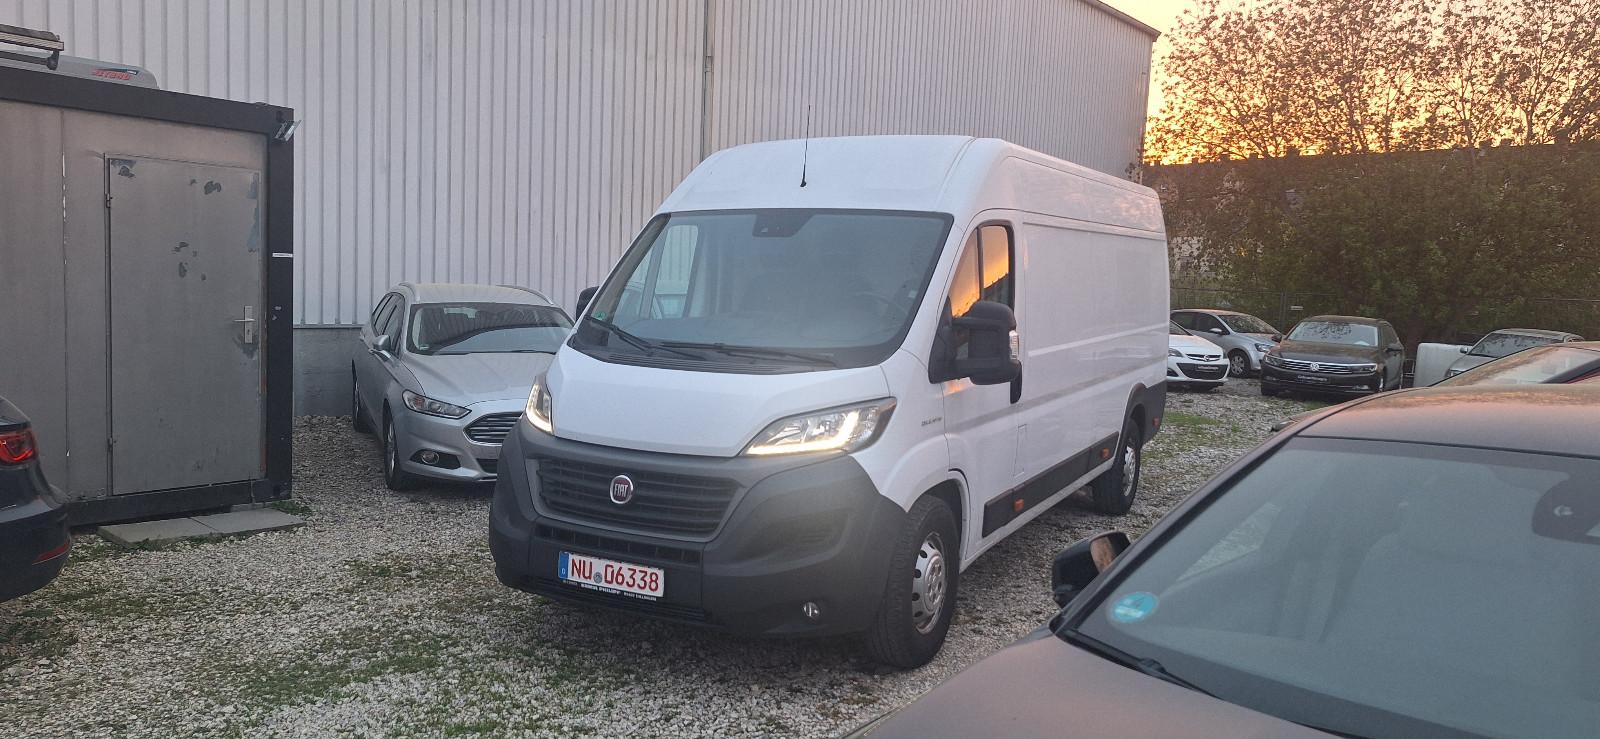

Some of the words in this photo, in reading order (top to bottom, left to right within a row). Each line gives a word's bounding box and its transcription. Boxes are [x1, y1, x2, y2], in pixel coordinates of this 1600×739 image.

[614, 483, 629, 497] FIAT
[571, 559, 593, 581] NU
[604, 564, 659, 592] 06338
